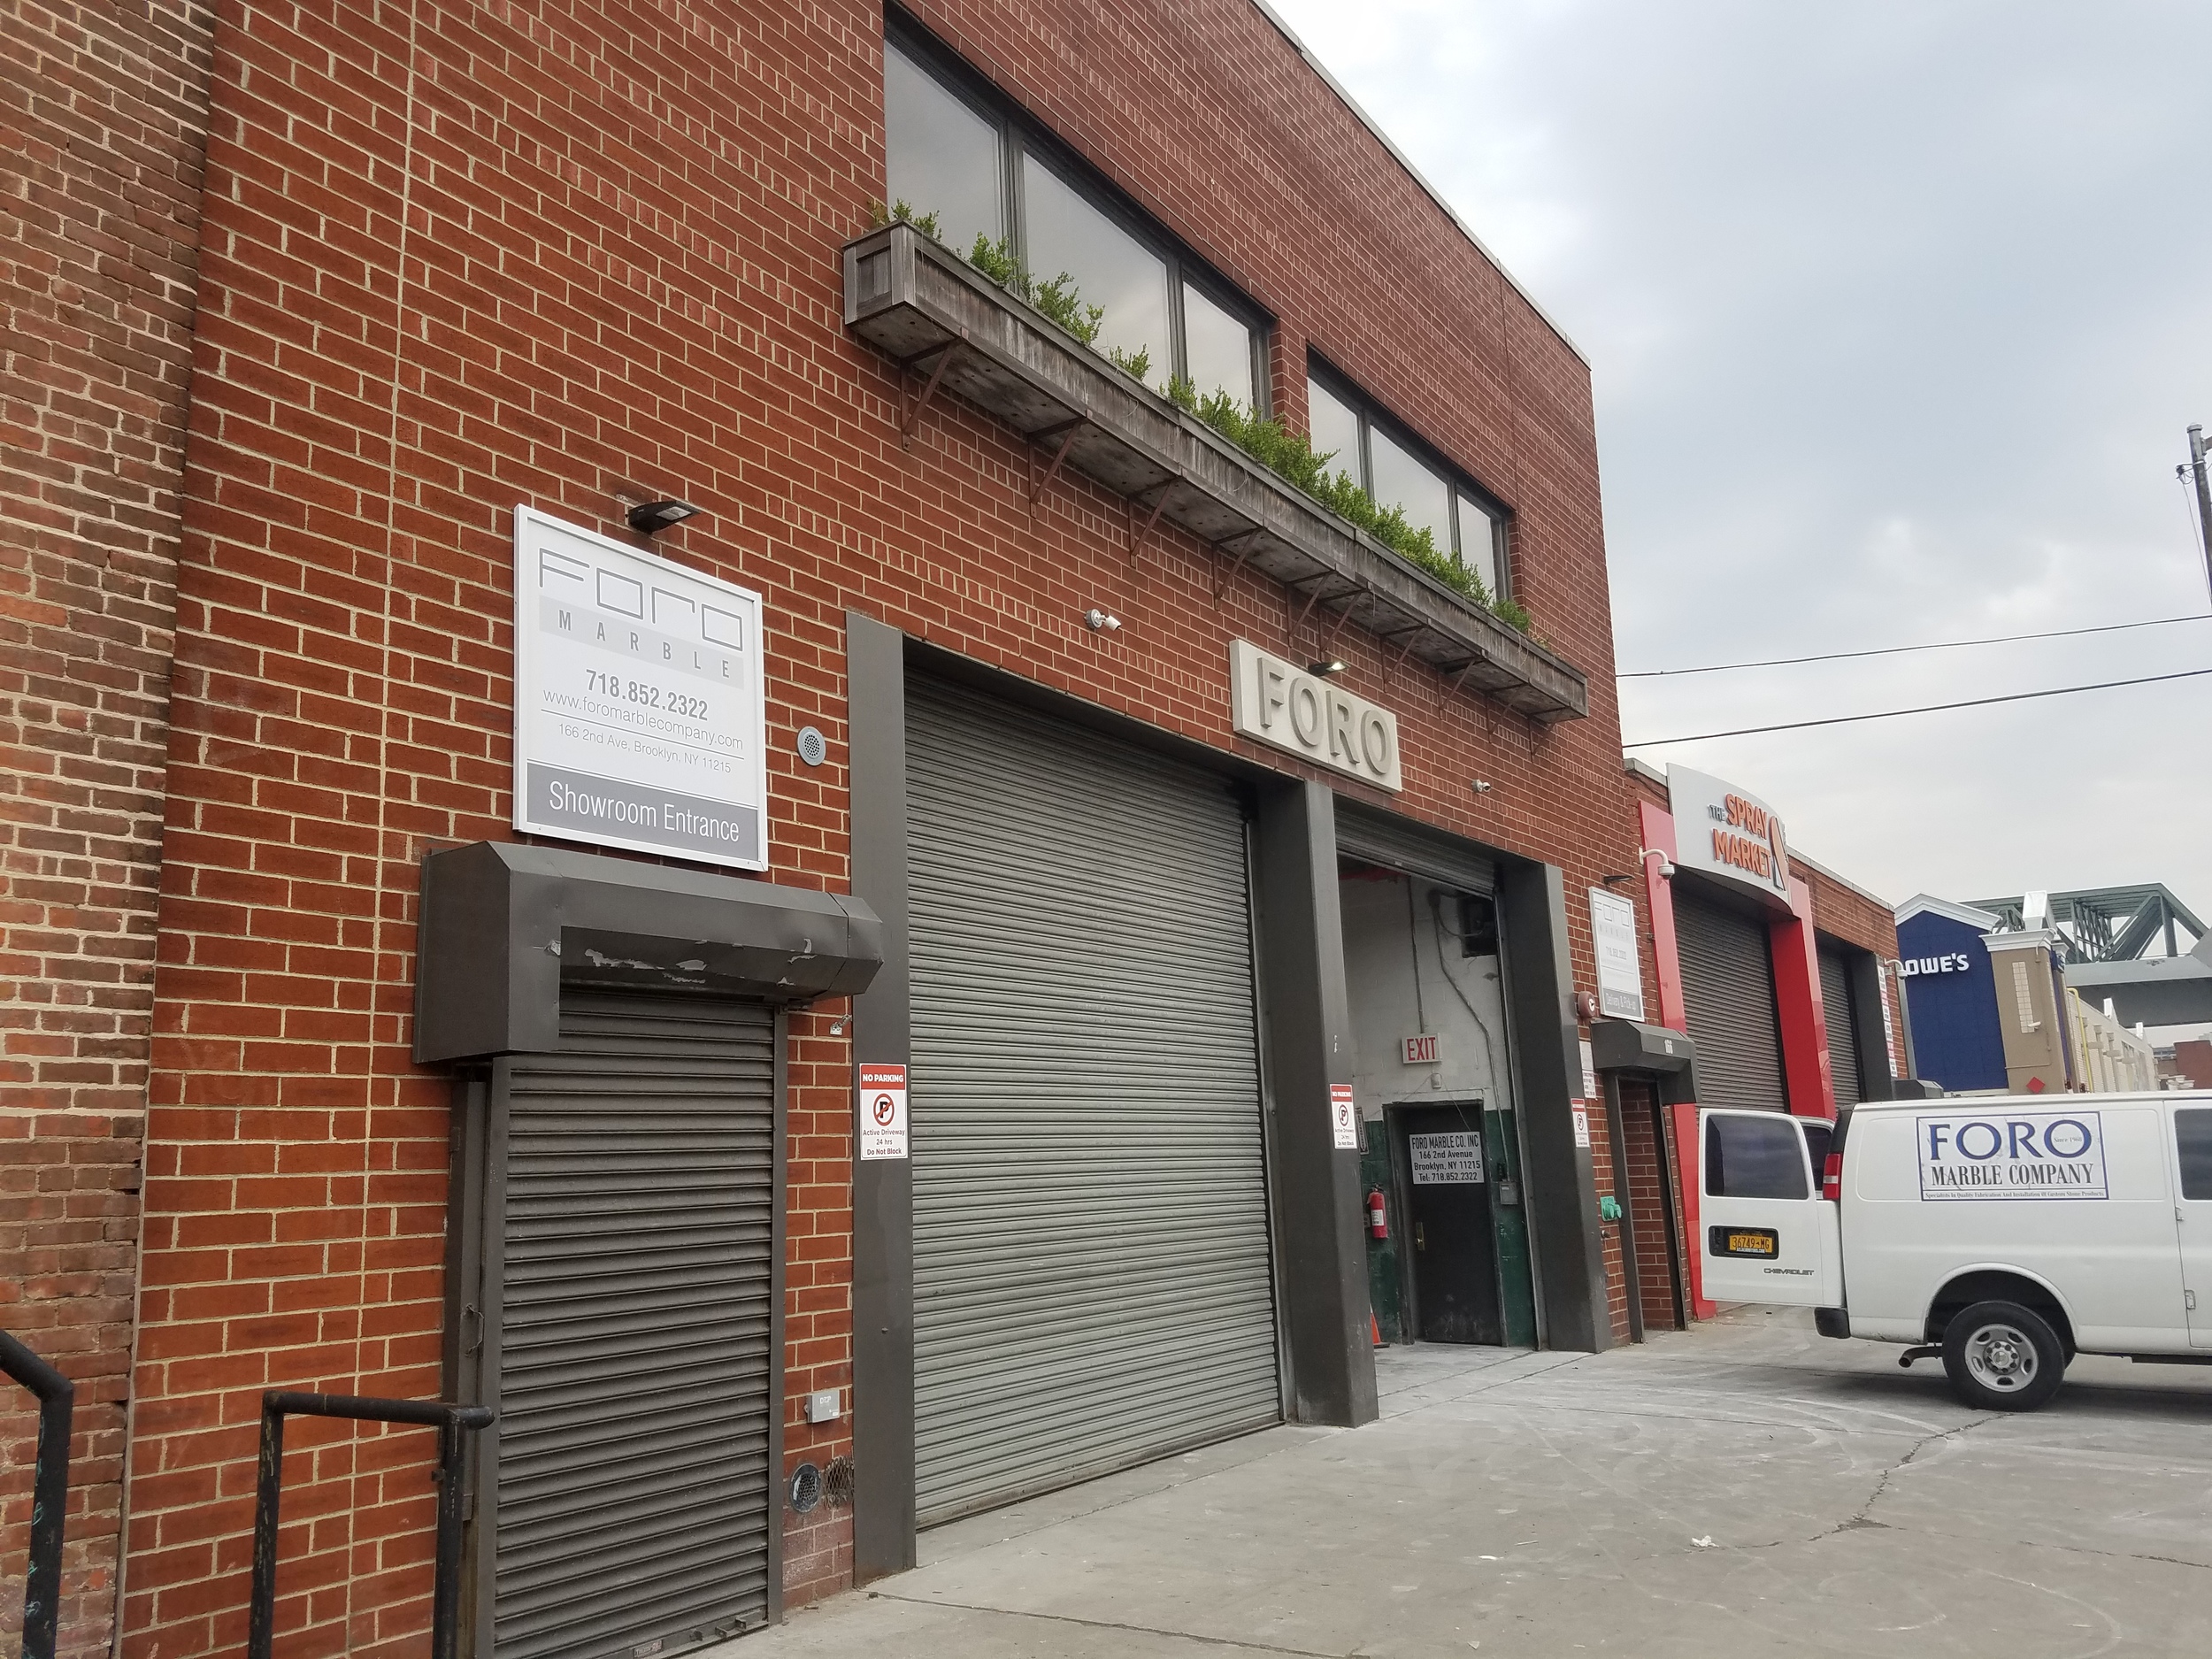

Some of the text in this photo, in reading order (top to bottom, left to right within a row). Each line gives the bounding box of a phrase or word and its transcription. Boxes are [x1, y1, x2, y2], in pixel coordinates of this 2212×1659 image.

[558, 609, 731, 679] MARBLE
[586, 668, 708, 721] 718.852.2322
[543, 689, 743, 749] www.foromarblecompany.com
[1257, 657, 1393, 776] FORO
[559, 723, 580, 738] 166
[582, 728, 603, 743] 2nd
[607, 734, 630, 751] Ave,
[685, 752, 699, 765] NY
[703, 757, 731, 773] 11215
[549, 780, 740, 842] Showroom Entrance
[1708, 793, 1767, 840] THE SPRAY
[1713, 828, 1771, 879] MARKET
[1904, 953, 1970, 976] OWE'S
[1407, 1036, 1436, 1061] EXIT
[862, 1073, 873, 1082] NO
[1411, 1134, 1479, 1149] FORO MARBLE CO. INC
[1432, 1150, 1446, 1159] 2nd
[1928, 1119, 2093, 1160] FORO
[1431, 1171, 1478, 1181] 718.852.2322
[1448, 1161, 1457, 1170] NY
[1459, 1160, 1481, 1169] 11215
[1931, 1163, 2094, 1186] MARBLE COMPANY
